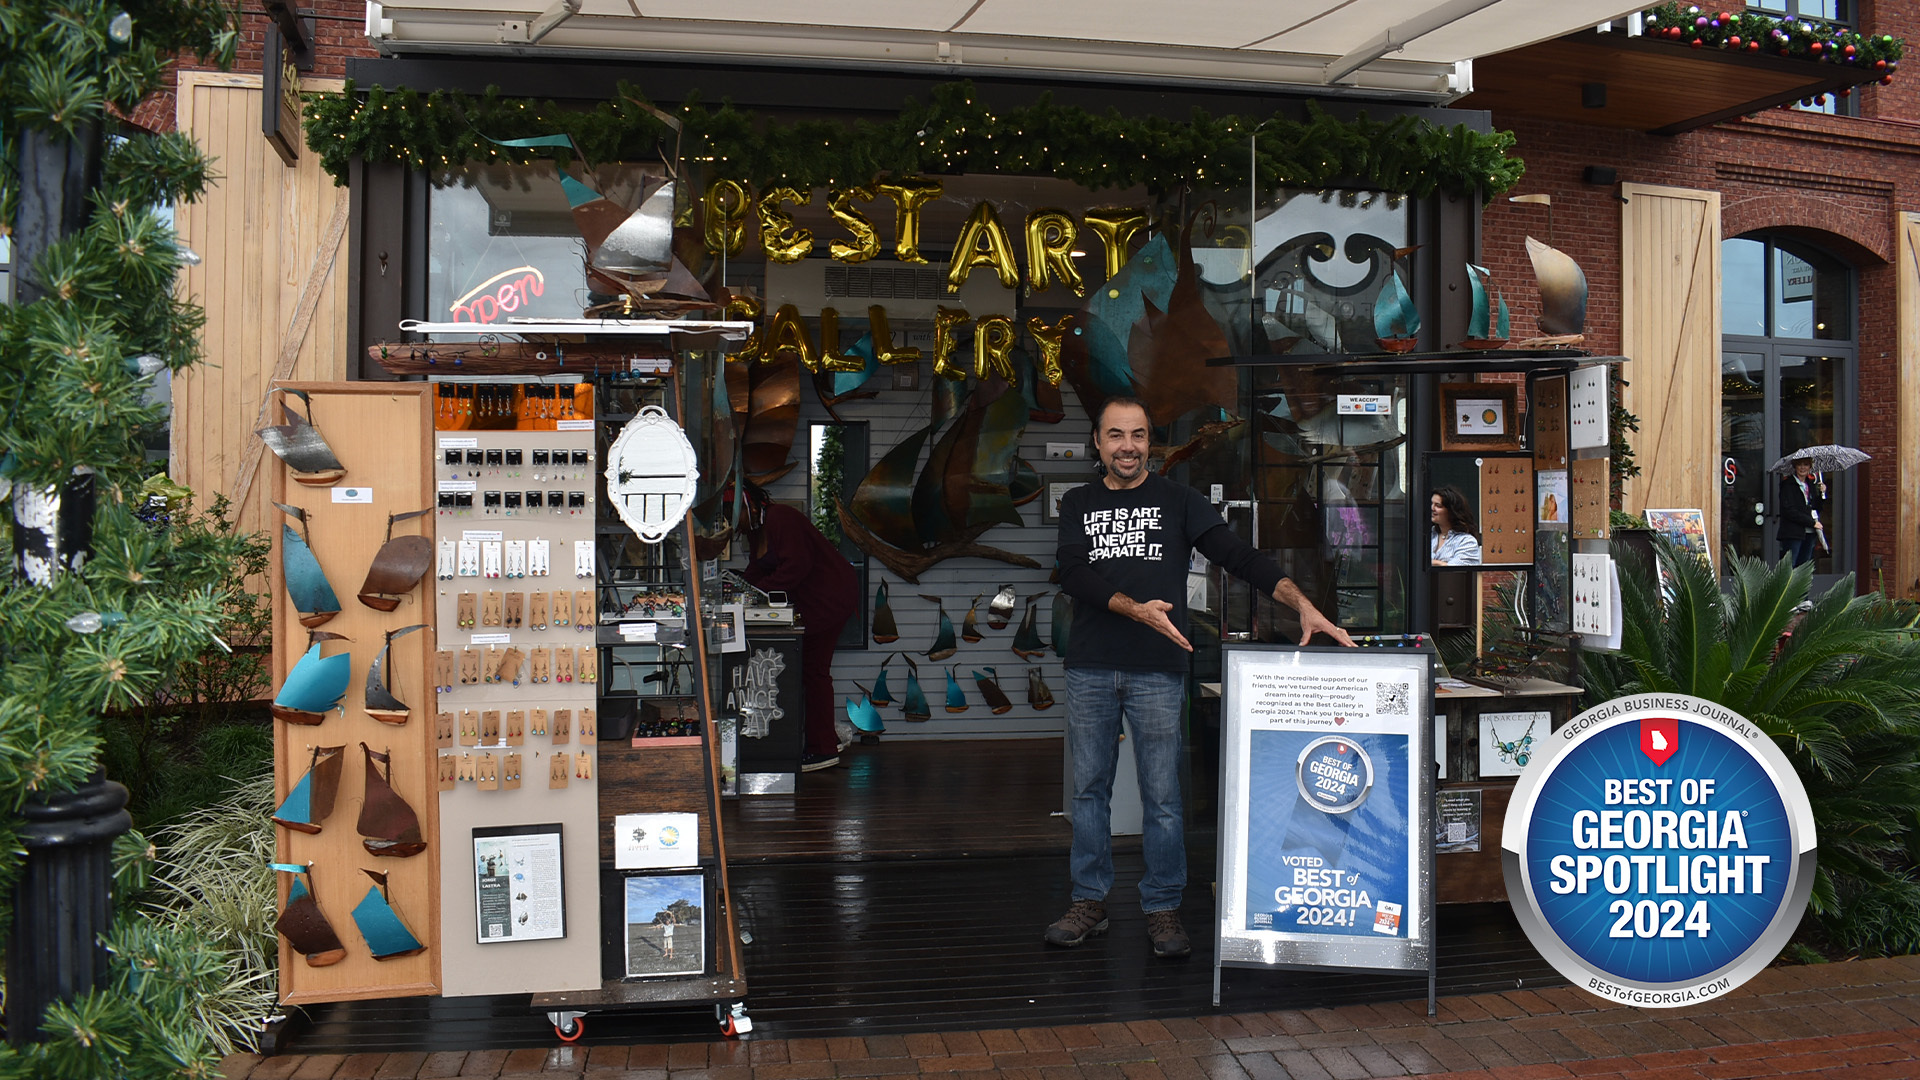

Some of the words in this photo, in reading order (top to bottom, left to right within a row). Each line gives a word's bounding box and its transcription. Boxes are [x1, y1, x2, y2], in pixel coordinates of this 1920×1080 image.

[703, 176, 943, 265] BEST
[947, 199, 1148, 297] ART
[453, 274, 544, 336] open
[725, 295, 1074, 388] GALLERY
[1084, 510, 1112, 524] LIFE
[1115, 508, 1128, 520] IS
[1131, 507, 1162, 519] ART.
[1085, 522, 1109, 536] ART
[1112, 520, 1126, 533] IS
[1128, 518, 1162, 531] LIFE.
[1092, 536, 1096, 548] I
[1098, 531, 1146, 547] NEVER
[1148, 544, 1162, 557] IT.
[732, 665, 778, 690] HAVE
[726, 692, 736, 710] A
[738, 688, 778, 710] NICE
[1332, 702, 1356, 710] Gallery
[1250, 708, 1276, 716] Georgia
[1494, 714, 1547, 722] BARCELONA
[1270, 717, 1284, 725] part
[1307, 718, 1332, 726] journey
[1323, 756, 1341, 768] BEST
[1342, 762, 1353, 771] OF
[1315, 776, 1346, 795] 2024
[1282, 856, 1323, 867] VOTED
[1294, 868, 1345, 887] BEST
[1347, 873, 1360, 886] of
[1275, 886, 1372, 909] GEORGIA
[1296, 907, 1355, 926] 2024!
